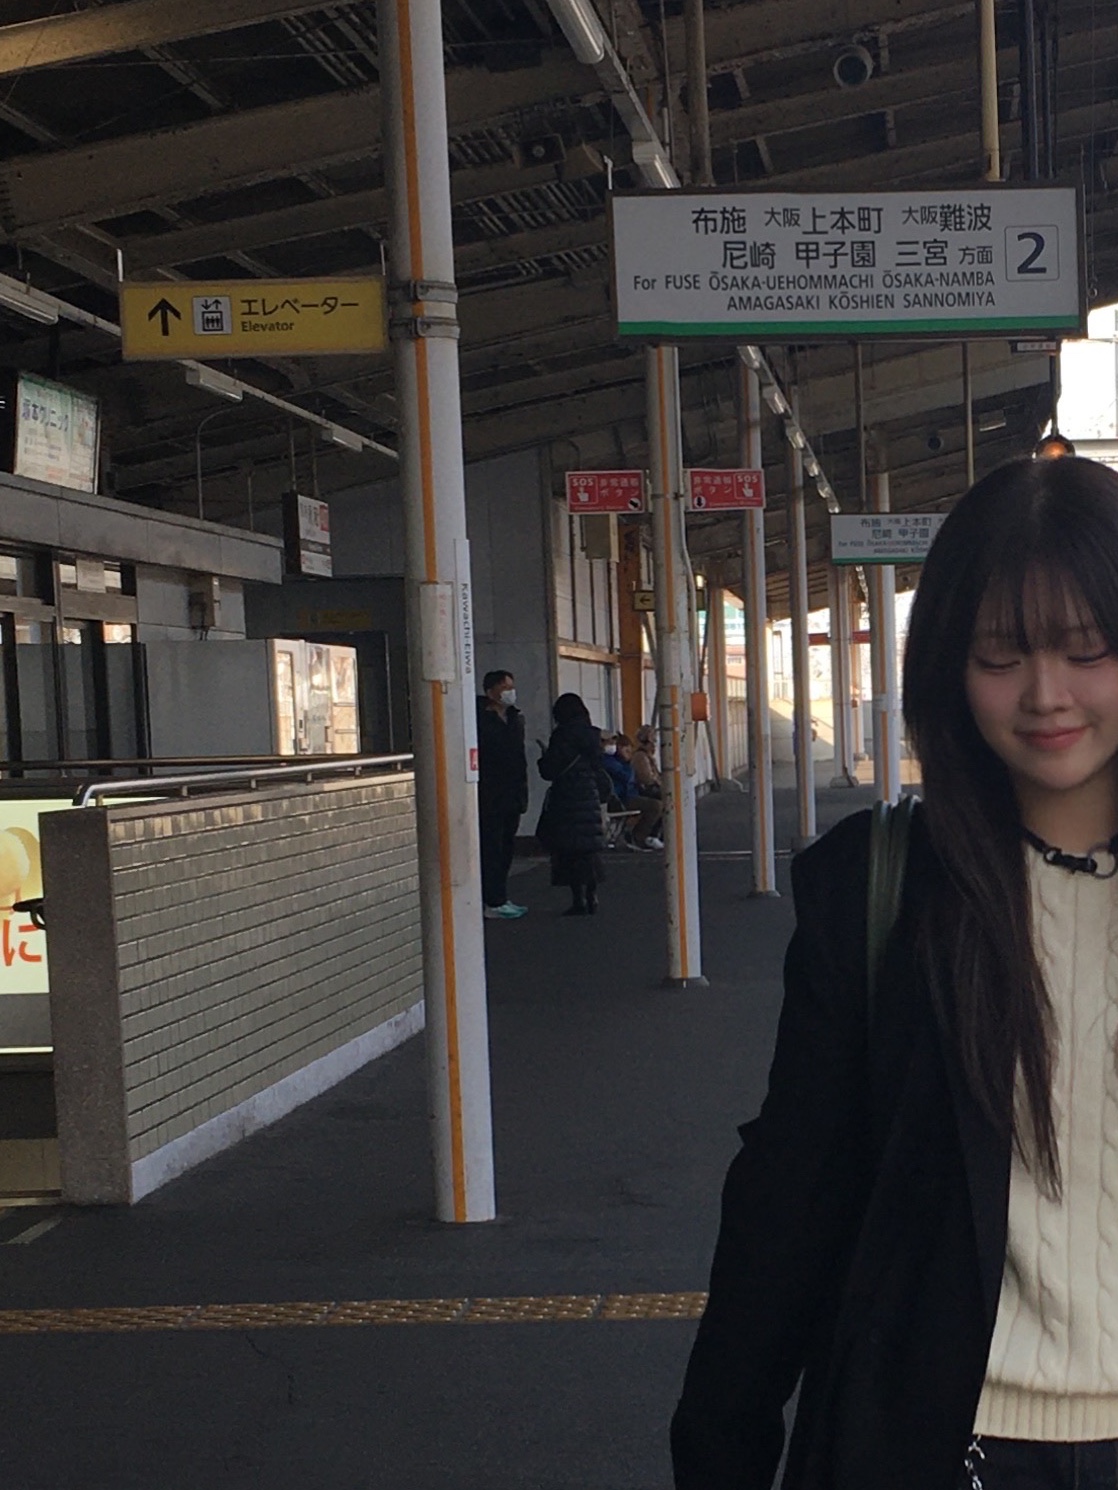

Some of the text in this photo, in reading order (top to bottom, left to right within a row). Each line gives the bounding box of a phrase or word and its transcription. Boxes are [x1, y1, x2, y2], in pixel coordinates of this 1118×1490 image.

[690, 206, 747, 235] 布施
[901, 203, 993, 233] 大阪難波
[721, 239, 994, 270] 尼崎 甲子園 三宮 方面
[1016, 231, 1048, 275] 2
[633, 275, 657, 291] For
[665, 274, 700, 290] FUSE
[240, 296, 359, 316] エレベーター
[727, 291, 996, 312] AMAGASAKI KŌSHIEN SANNOMIYA
[241, 321, 294, 332] Elevator
[572, 478, 594, 487] SOS
[737, 474, 758, 483] SOS
